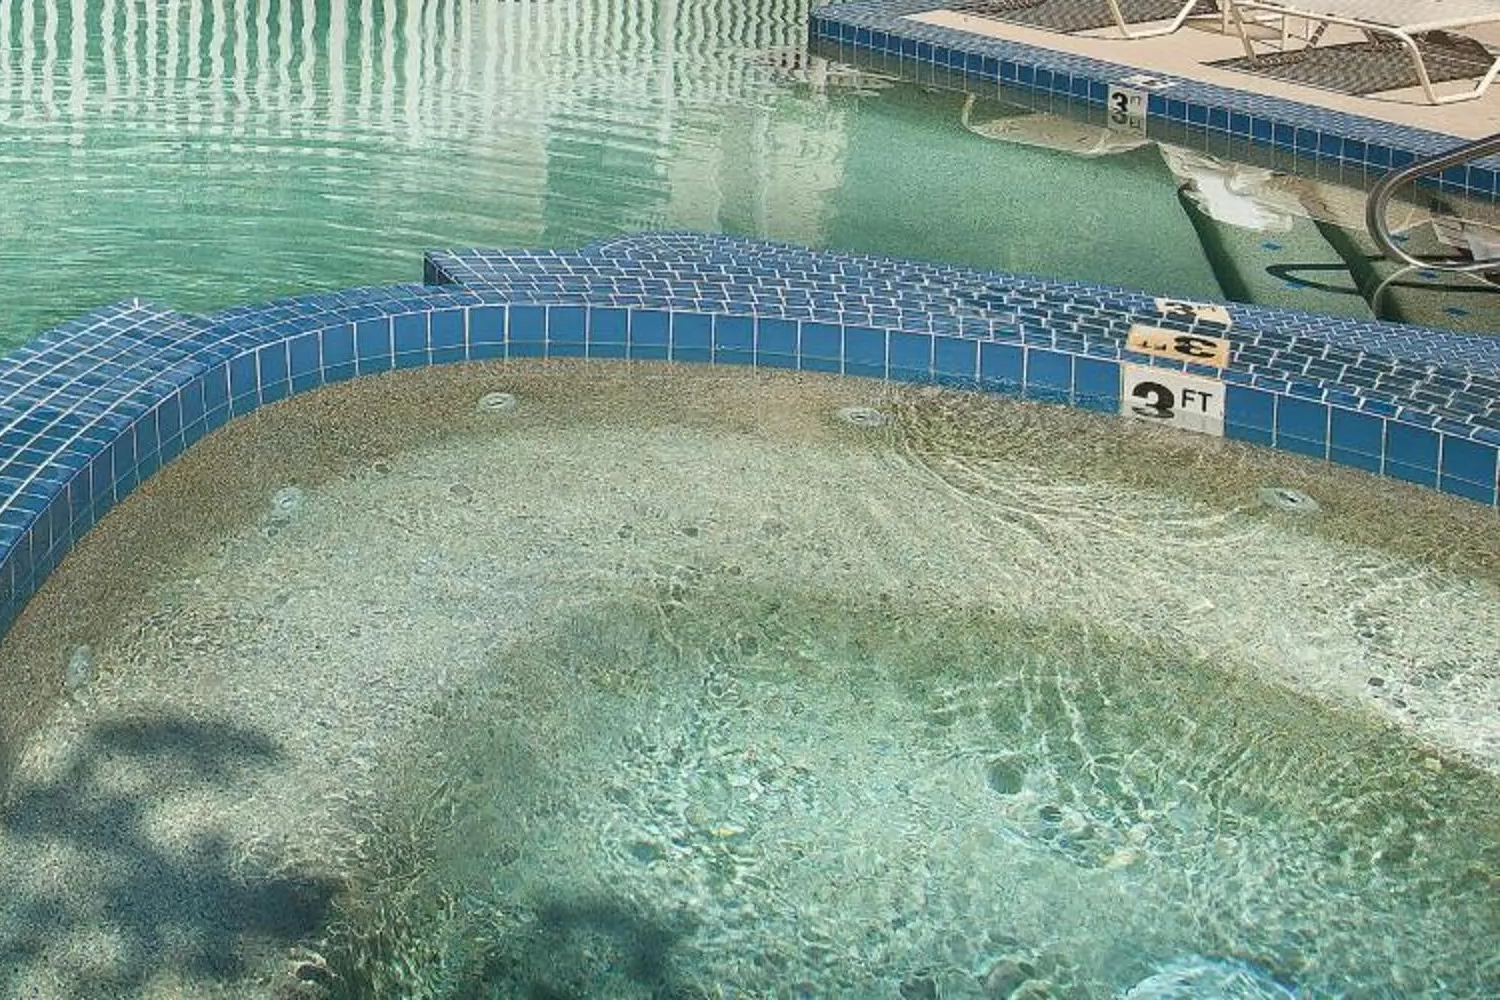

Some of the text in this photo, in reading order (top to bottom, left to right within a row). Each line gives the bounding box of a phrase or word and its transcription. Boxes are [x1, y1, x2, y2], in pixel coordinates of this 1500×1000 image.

[1111, 91, 1128, 119] 3
[1174, 335, 1218, 358] 3
[1132, 381, 1213, 418] 3 FT
